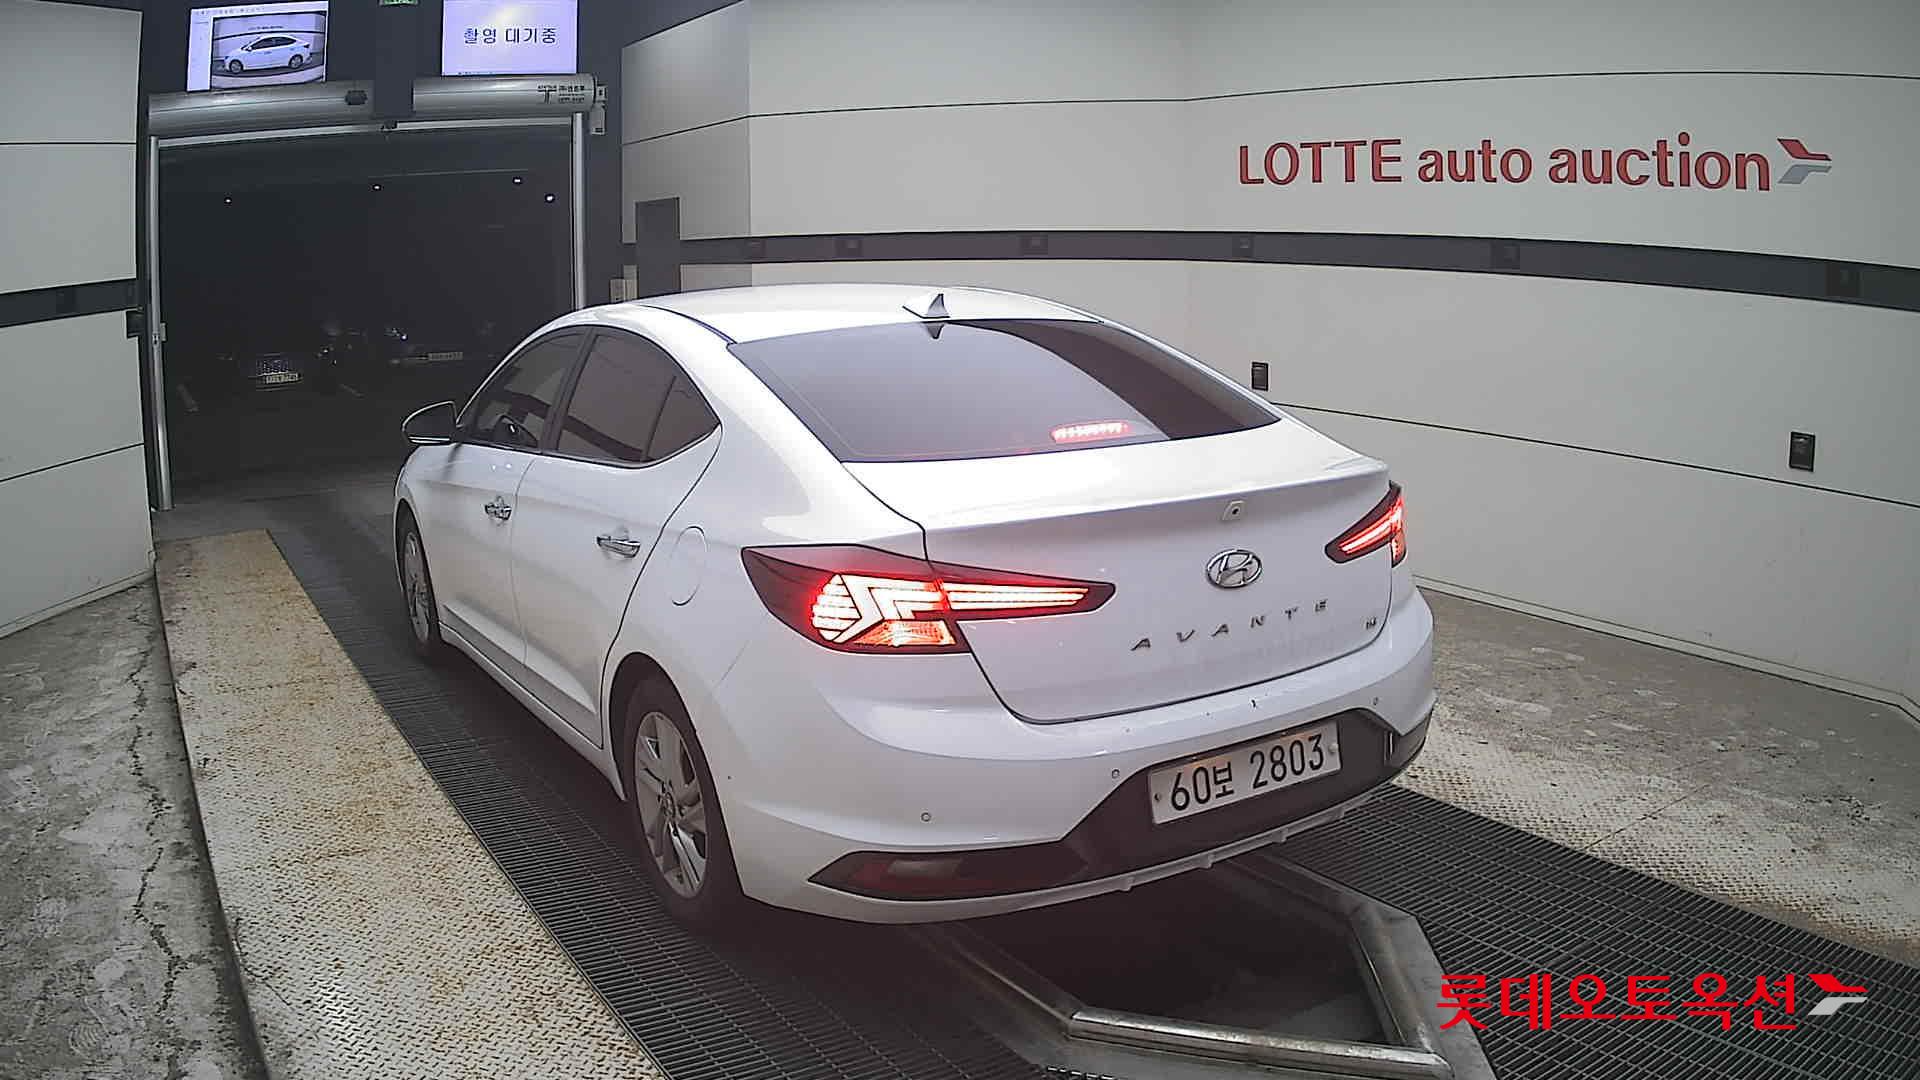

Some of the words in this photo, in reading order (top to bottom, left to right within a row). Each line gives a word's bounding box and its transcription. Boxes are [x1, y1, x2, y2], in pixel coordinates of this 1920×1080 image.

[505, 27, 557, 44] 대기중
[1239, 138, 1402, 185] LOTTE
[1417, 139, 1533, 184] auto
[1548, 131, 1771, 191] auction
[1131, 599, 1328, 651] AVANTE
[1171, 761, 1235, 811] 60보
[1250, 734, 1324, 789] 2803
